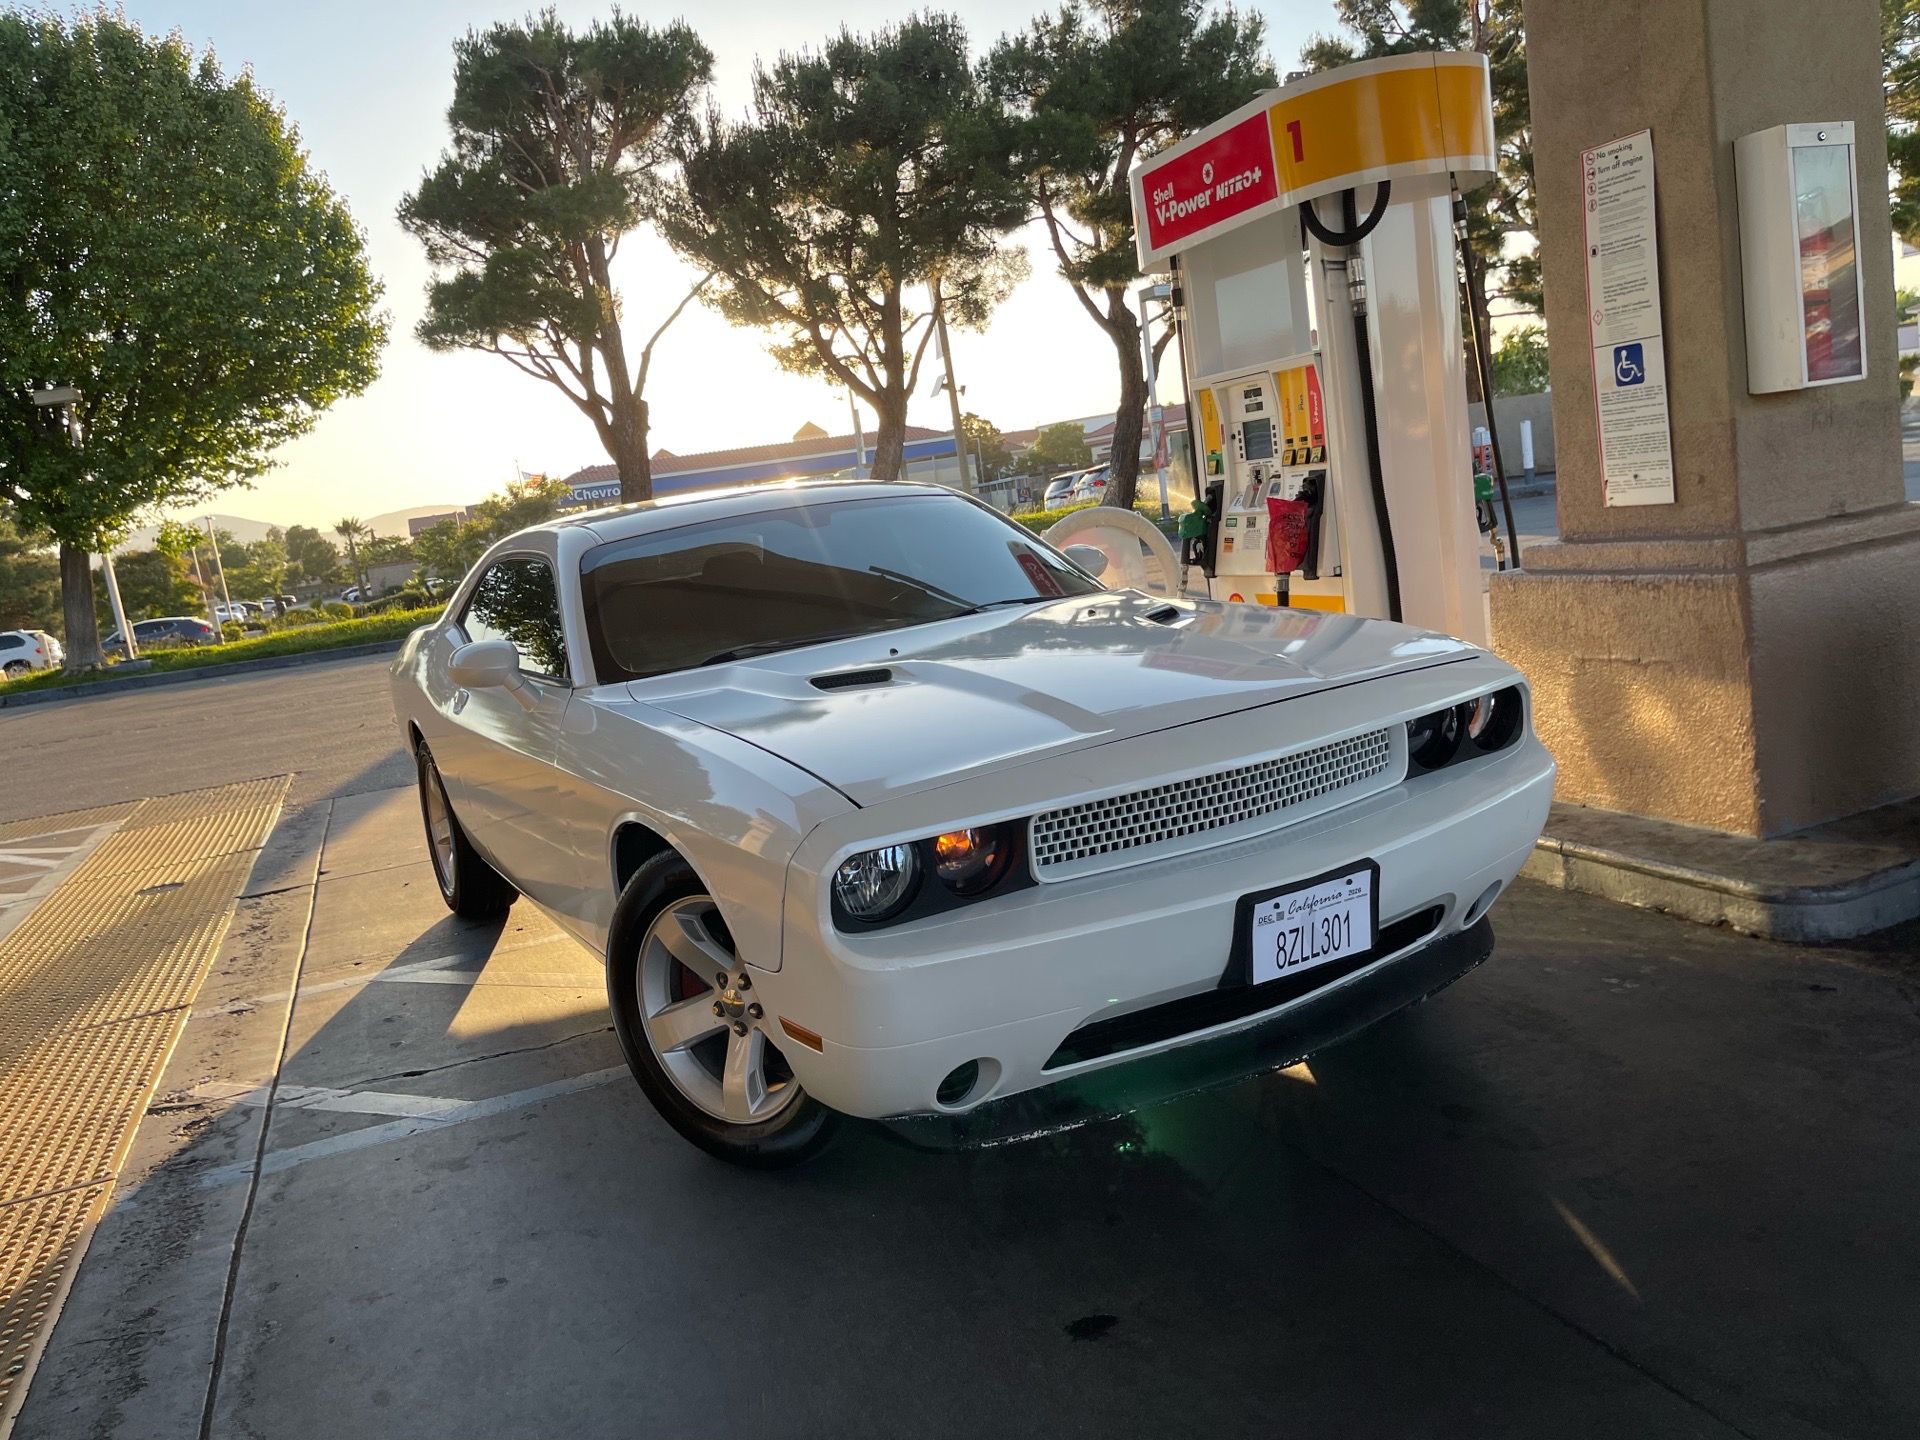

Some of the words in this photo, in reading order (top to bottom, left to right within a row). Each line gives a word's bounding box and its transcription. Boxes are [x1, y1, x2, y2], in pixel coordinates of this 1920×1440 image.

[1286, 119, 1304, 163] 1
[1608, 143, 1633, 156] smoking
[1612, 160, 1620, 170] off
[1153, 182, 1174, 206] Shell
[1155, 188, 1213, 227] V-Power
[574, 487, 621, 501] Chevro
[1258, 914, 1273, 924] DEC
[1288, 889, 1343, 916] California
[1276, 910, 1351, 970] 8ZLL301
